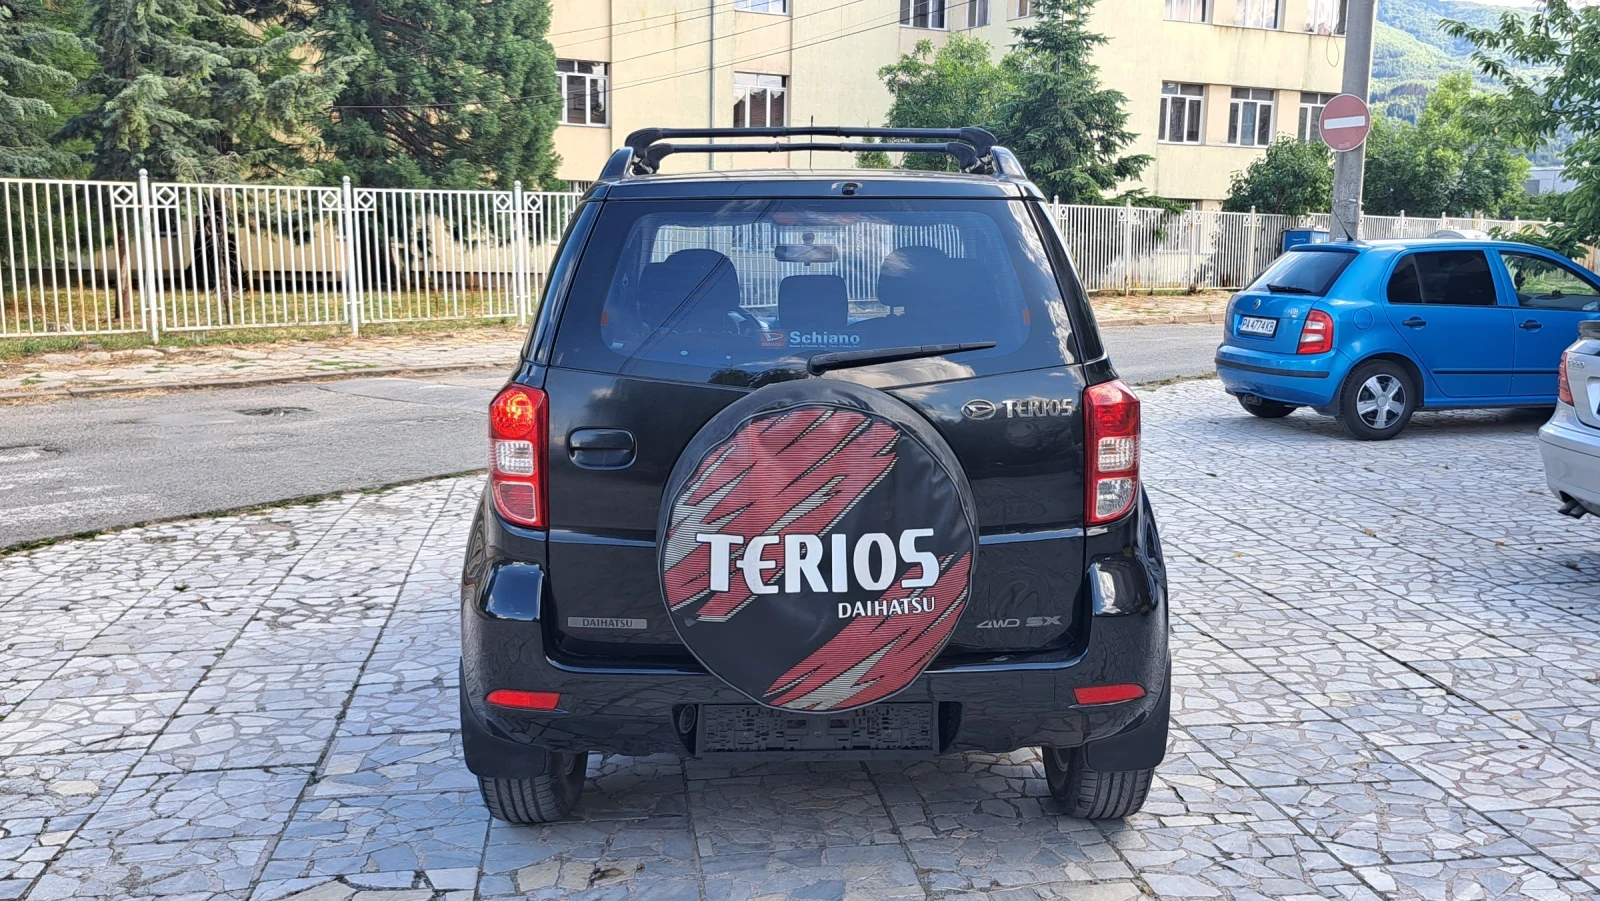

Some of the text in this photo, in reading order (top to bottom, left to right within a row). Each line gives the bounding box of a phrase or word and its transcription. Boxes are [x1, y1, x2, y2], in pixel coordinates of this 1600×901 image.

[789, 331, 860, 344] Schiano
[1002, 398, 1073, 419] TERIOS
[696, 528, 940, 595] TERIOS
[838, 596, 935, 619] DAIHATSU
[582, 618, 633, 628] DAIHATSU
[976, 615, 1063, 629] 4WD SX
